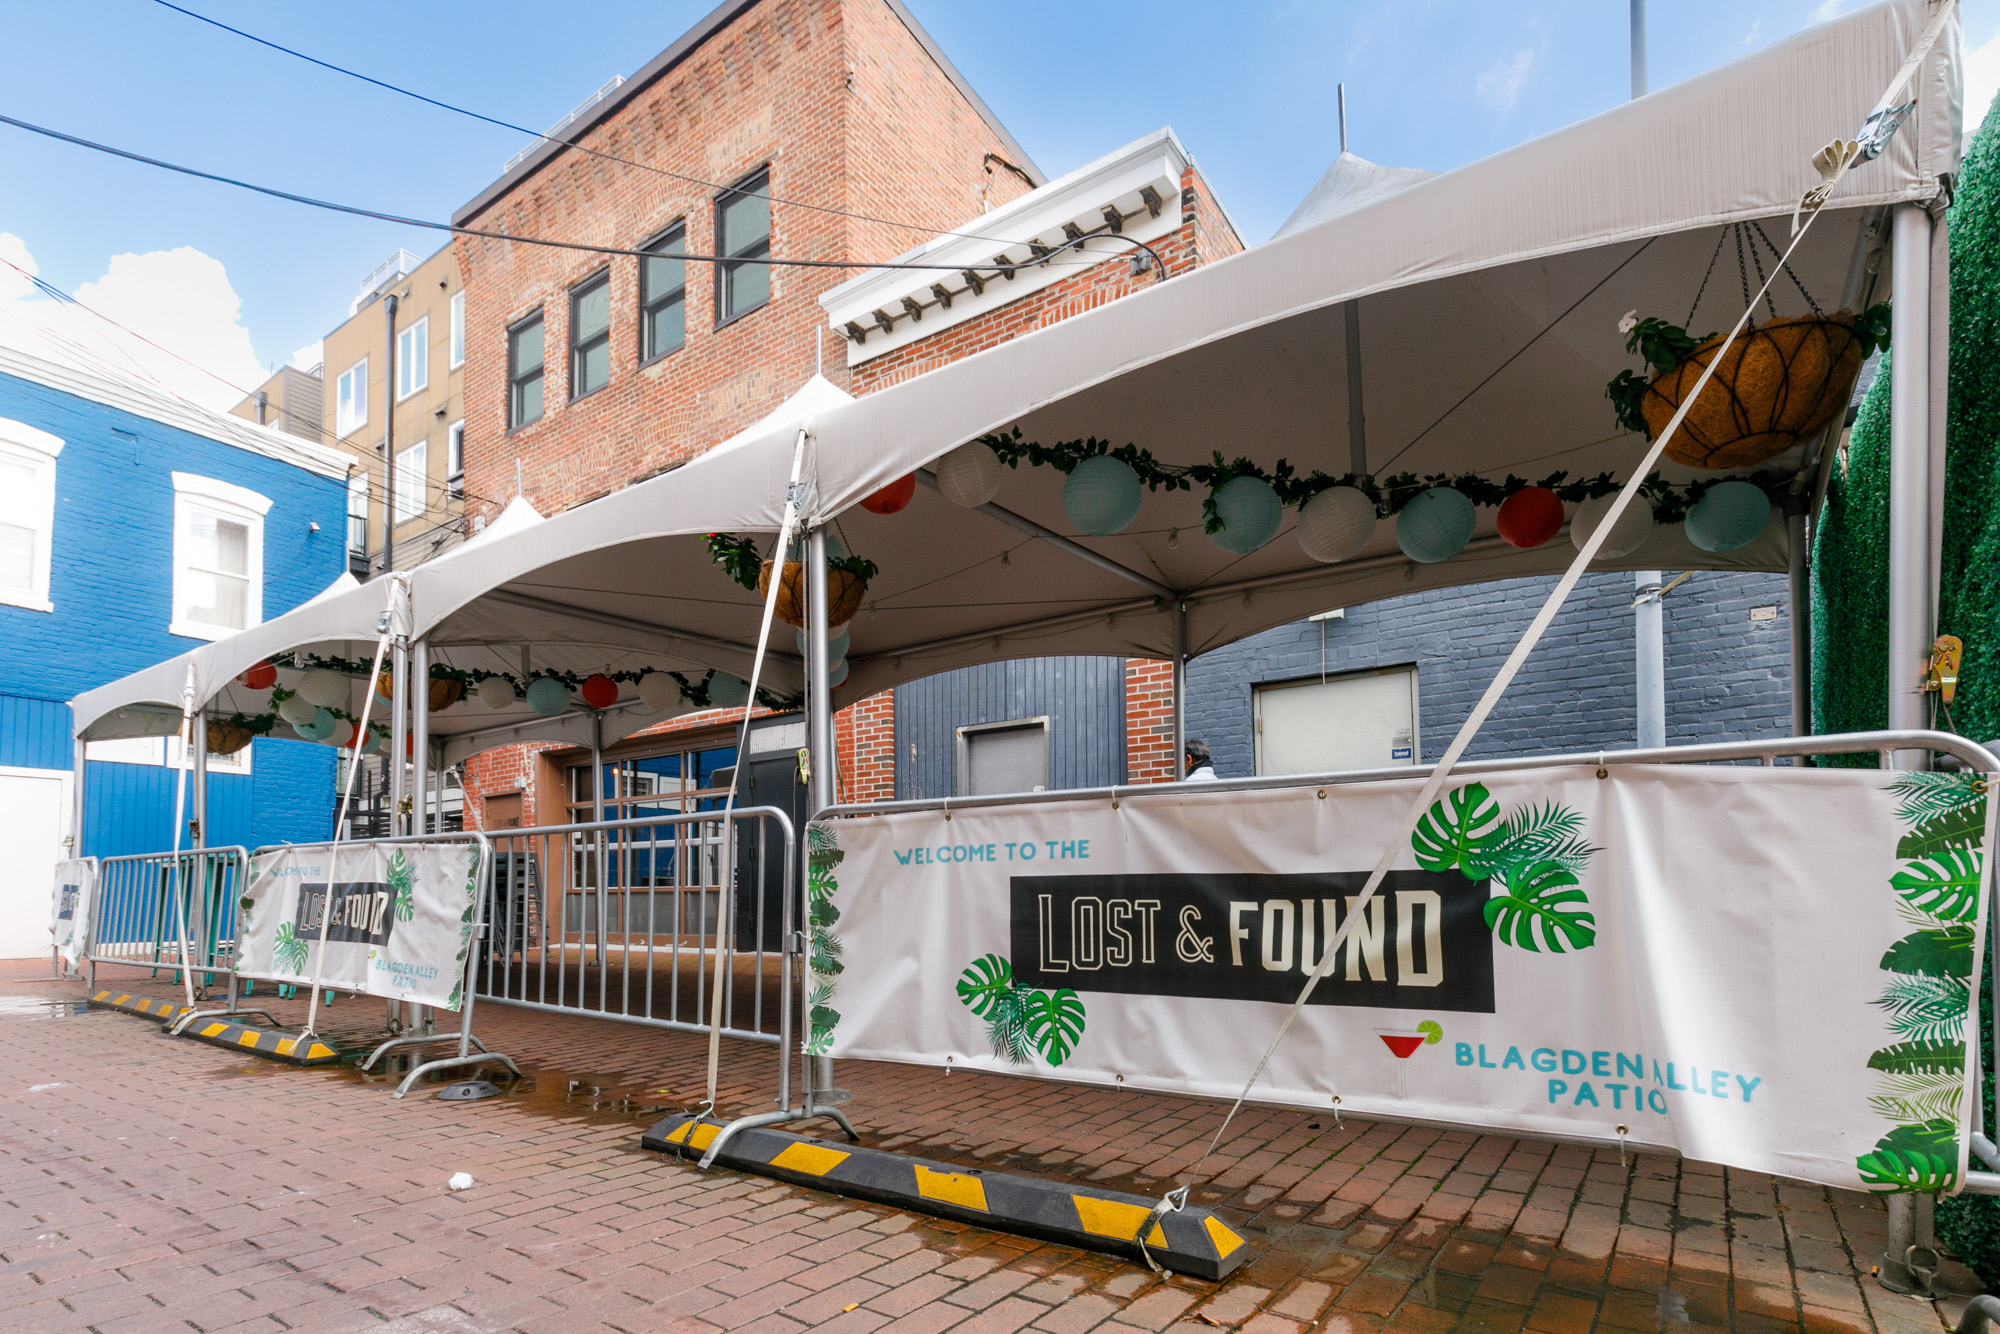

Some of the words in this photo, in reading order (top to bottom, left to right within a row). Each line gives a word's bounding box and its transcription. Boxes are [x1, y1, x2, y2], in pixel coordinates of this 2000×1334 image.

[893, 844, 996, 866] WELCOME
[1005, 842, 1037, 861] TO
[1045, 839, 1090, 860] THE
[310, 866, 321, 876] THE
[300, 892, 333, 931] LOS
[331, 897, 342, 926] &
[1038, 894, 1161, 973] LOST
[1175, 904, 1214, 963] &
[1229, 889, 1444, 988] FOUND
[375, 959, 414, 975] BLAGDEN
[415, 966, 439, 979] ALLEY
[392, 975, 417, 989] PATIO
[1455, 1042, 1644, 1080] BLAGDEN
[1653, 1058, 1761, 1103] ALLEY
[1548, 1078, 1668, 1115] PATIO
